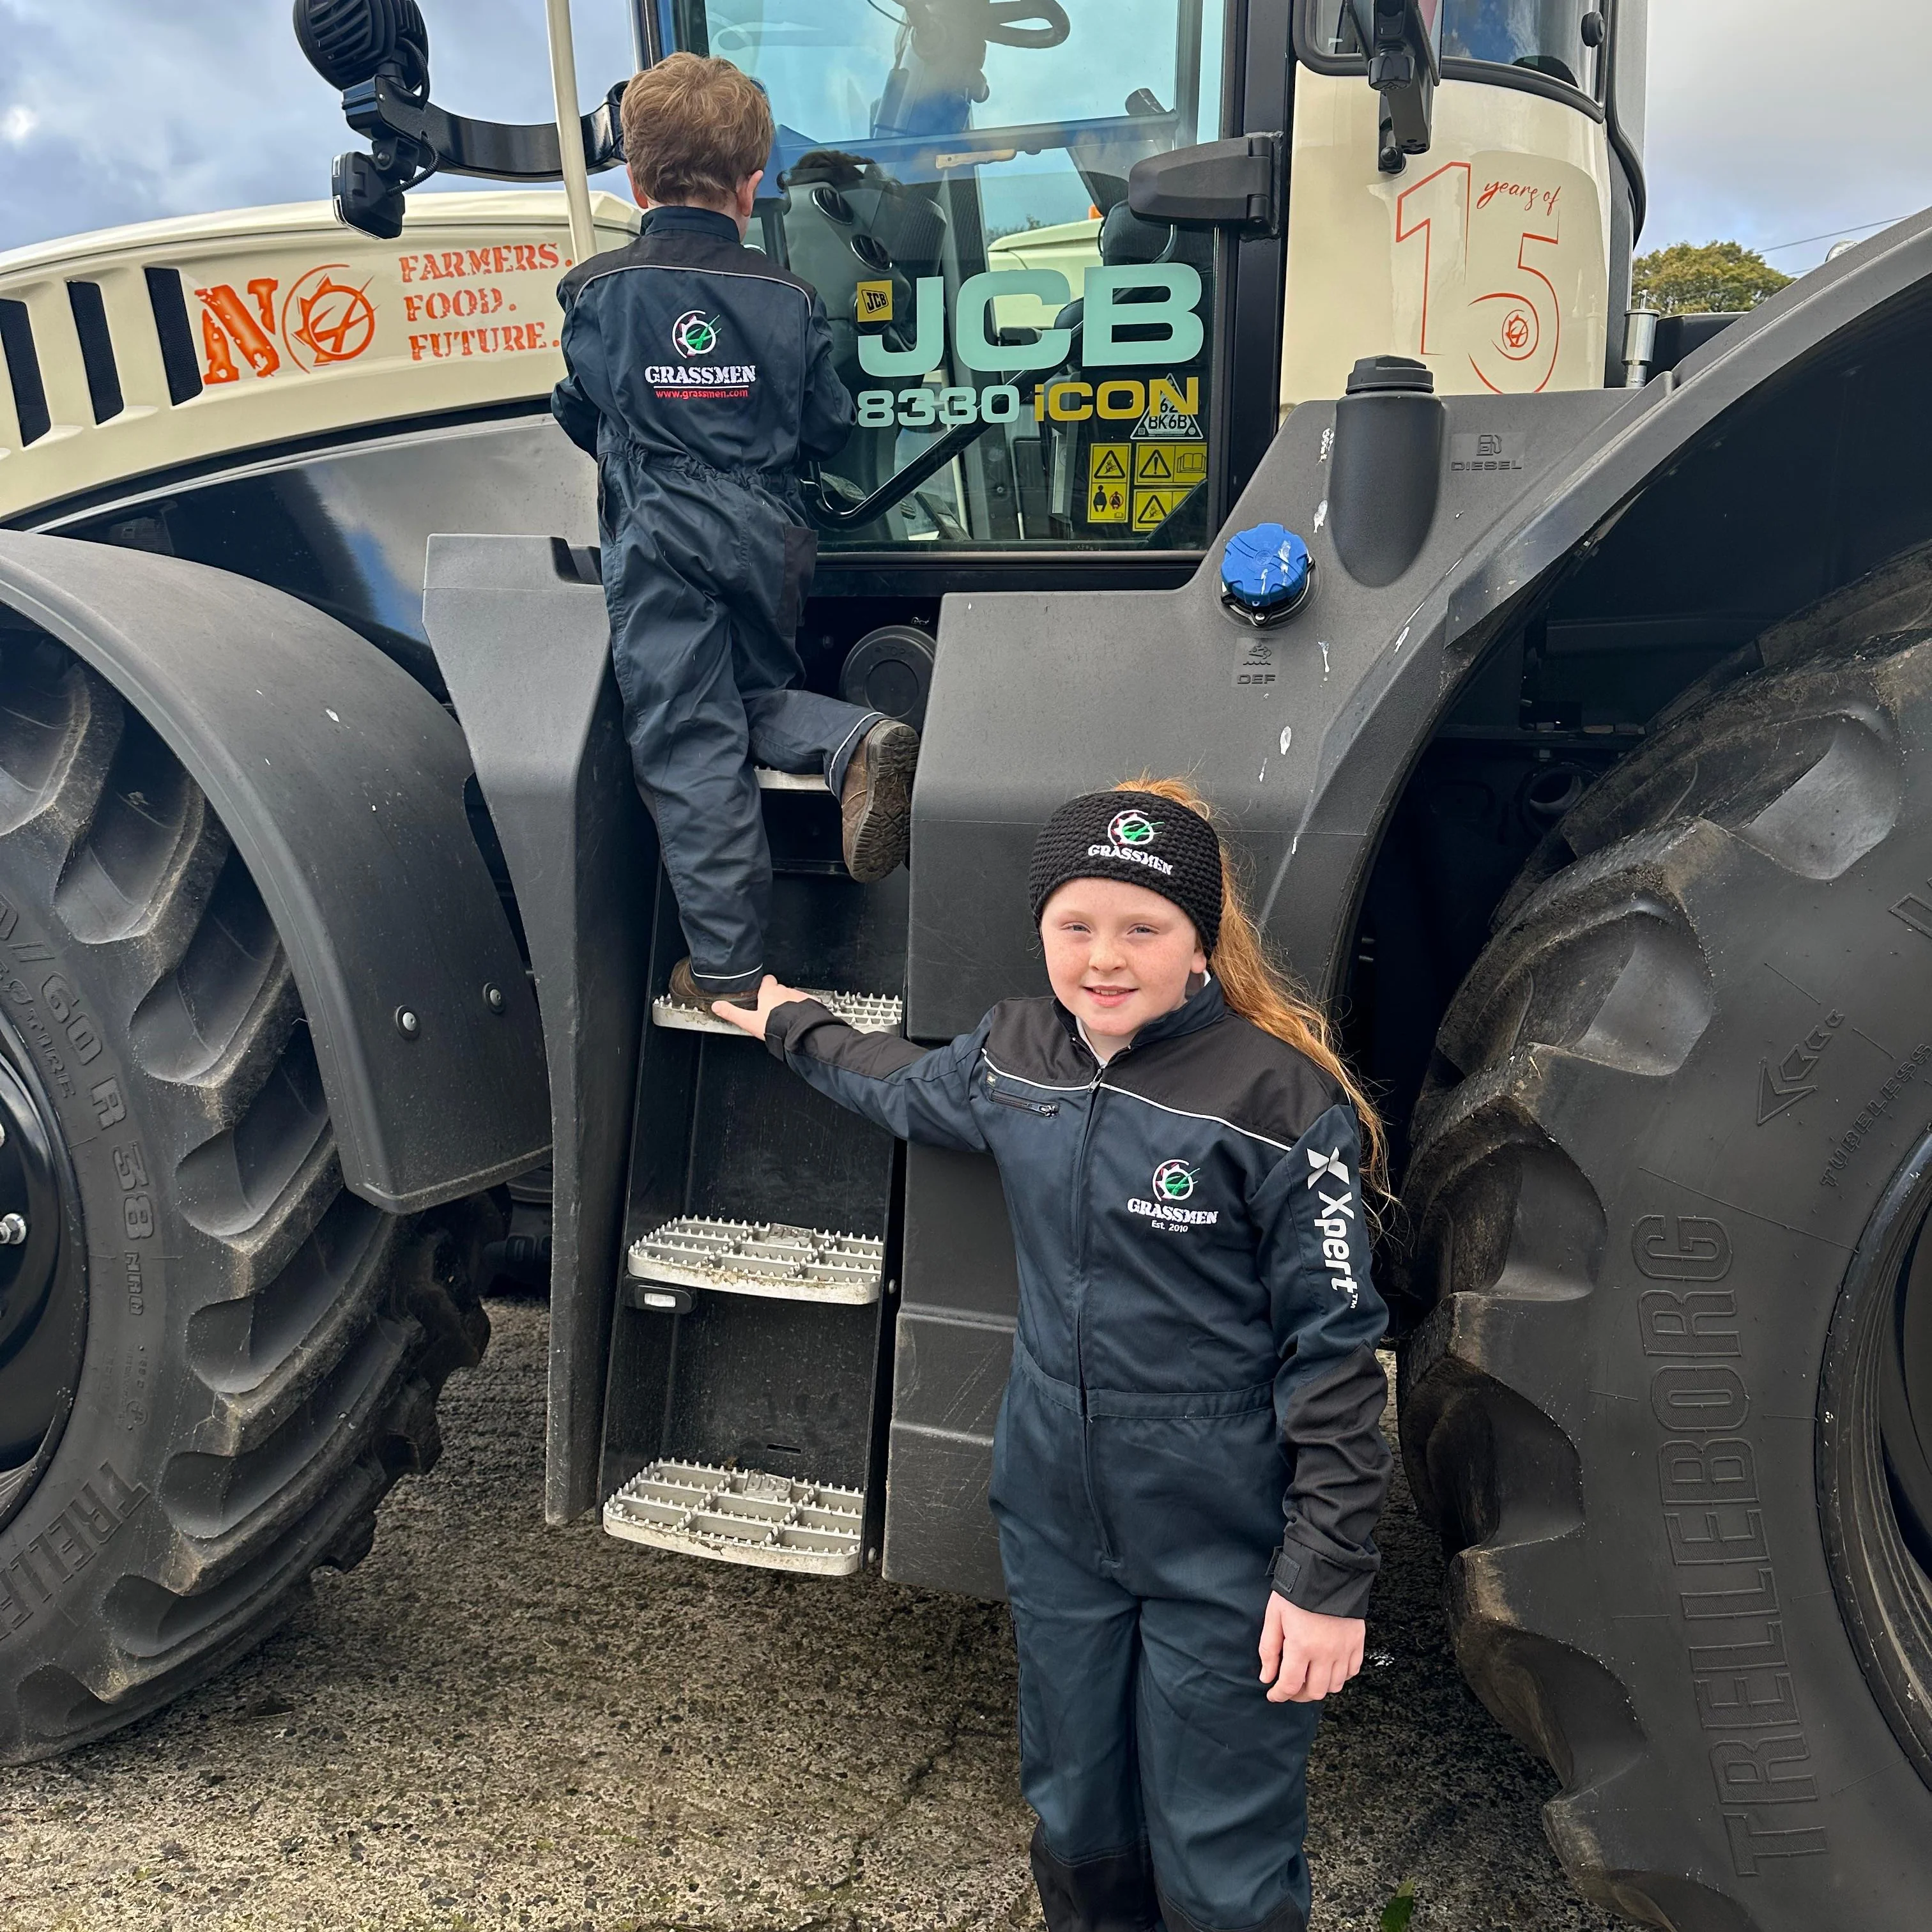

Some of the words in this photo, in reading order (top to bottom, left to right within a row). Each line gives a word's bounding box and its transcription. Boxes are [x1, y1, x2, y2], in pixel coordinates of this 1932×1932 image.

[1476, 181, 1538, 210] years
[1543, 186, 1561, 216] of
[398, 242, 573, 283] FARMERS.
[403, 288, 517, 322] FOOD.
[866, 291, 887, 311] JCB
[857, 263, 1204, 378] JCB
[408, 321, 560, 361] FUTURE.
[644, 365, 756, 385] GRASSMEN
[656, 388, 749, 400] www.grassmen.com
[857, 385, 1020, 428] 8330
[1034, 376, 1199, 422] iCON
[1148, 414, 1188, 430] BK6B
[1450, 460, 1522, 471] DIESEL
[1236, 674, 1276, 685] DEF
[1087, 844, 1174, 875] GRASSMEN
[90, 1074, 126, 1131] R
[1820, 1043, 1932, 1187] TUBELESS
[1127, 1197, 1219, 1225] GRASSMEN
[1151, 1220, 1166, 1230] Est.
[1168, 1223, 1189, 1233] 2010
[0, 1459, 151, 1641] TRELLE
[1632, 1214, 1828, 1876] TRELLEBORG
